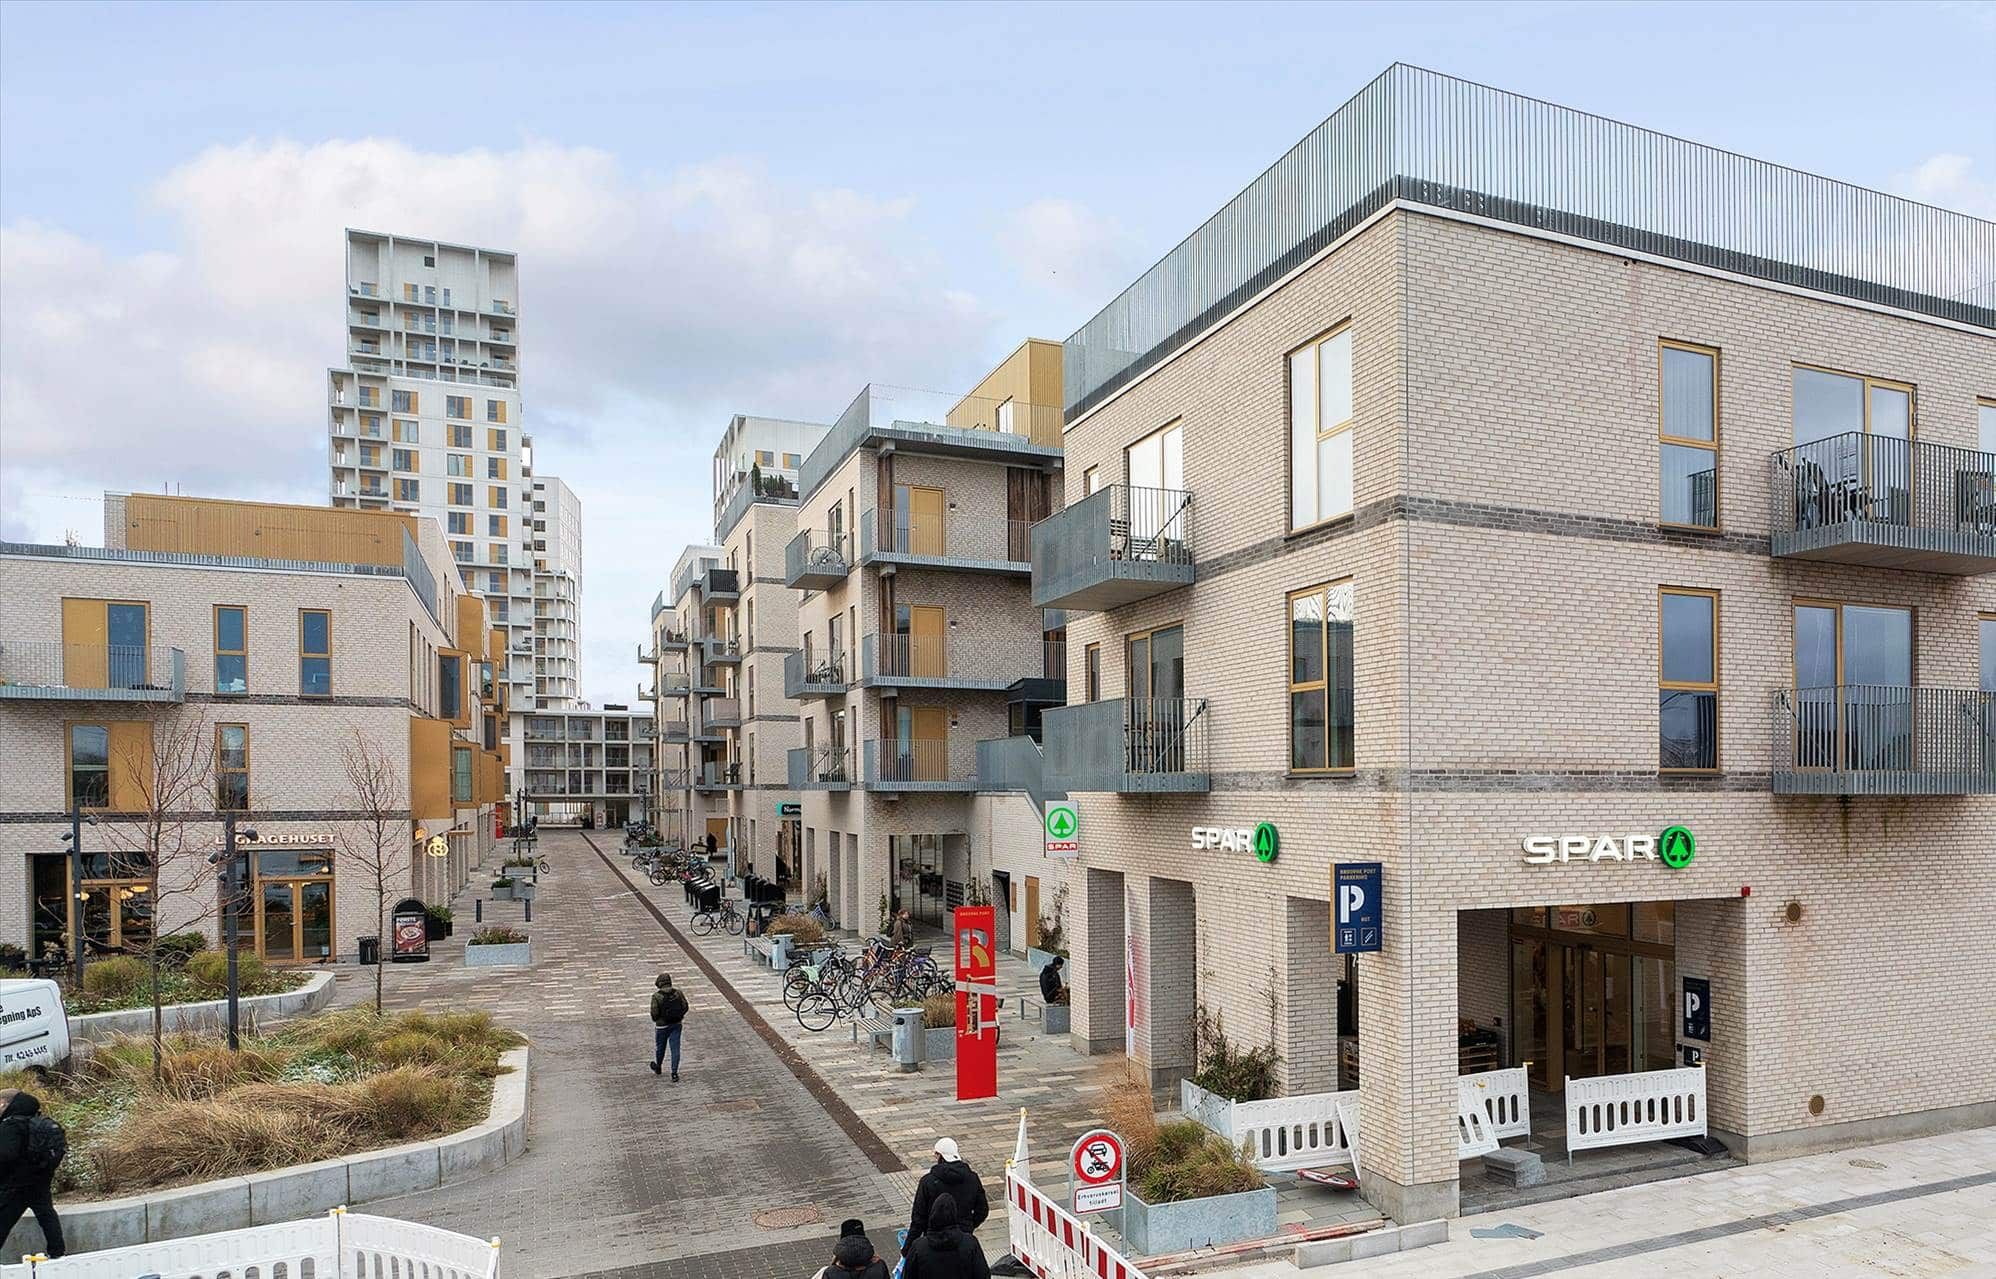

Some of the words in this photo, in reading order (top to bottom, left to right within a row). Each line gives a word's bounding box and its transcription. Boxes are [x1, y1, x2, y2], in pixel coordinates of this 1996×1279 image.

[215, 834, 336, 845] LGAGEHUSET
[1048, 843, 1077, 851] SPAR
[1192, 826, 1253, 853] SPAR
[1522, 834, 1655, 864] SPAR
[1340, 885, 1365, 924] P
[26, 1006, 42, 1018] ApS
[1686, 991, 1701, 1019] P
[1692, 1050, 1699, 1062] P
